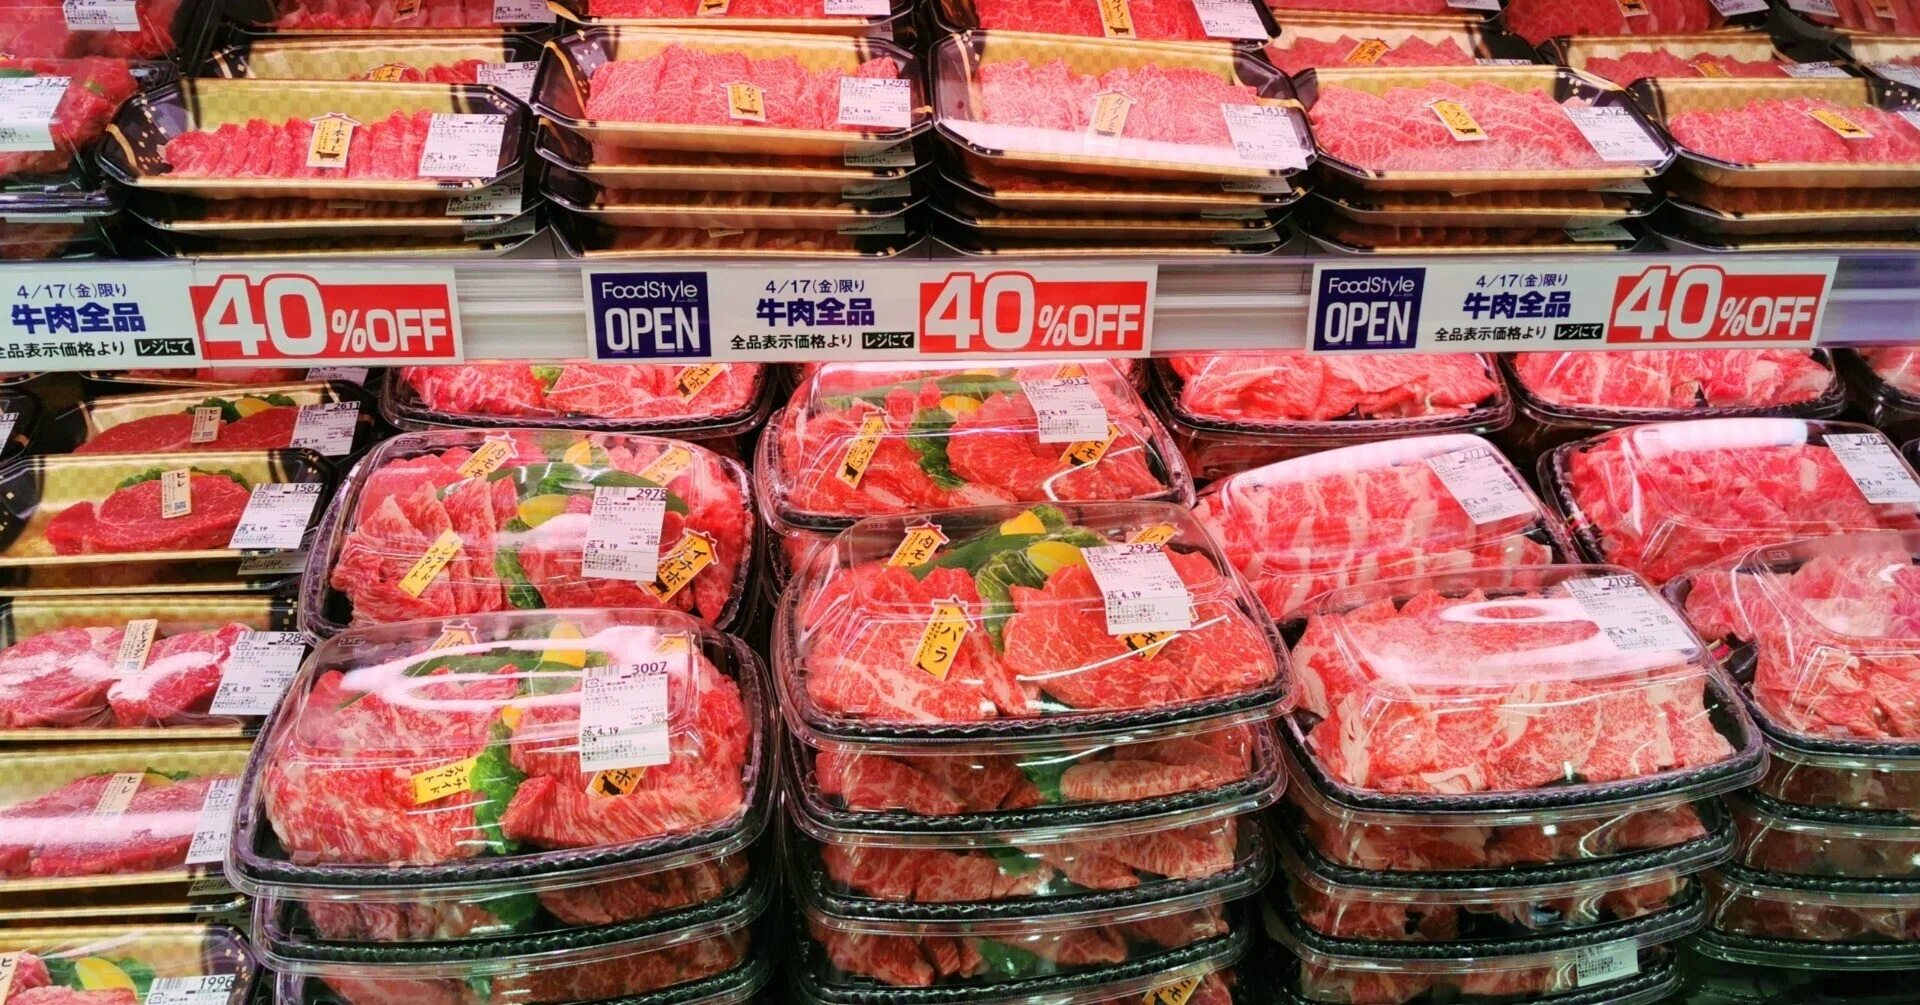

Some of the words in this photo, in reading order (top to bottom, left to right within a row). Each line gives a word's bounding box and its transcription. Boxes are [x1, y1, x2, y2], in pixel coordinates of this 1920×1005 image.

[765, 279, 866, 294] 4/17(金)限り
[1327, 276, 1416, 297] FoodStyle
[1475, 273, 1569, 289] 4/17(金)限り
[16, 283, 127, 299] 4/17(金)限り
[602, 280, 698, 302] FoodStyle
[756, 298, 875, 327] 牛肉全品
[1462, 291, 1572, 320] 牛肉全品
[11, 302, 147, 335] 牛肉全品
[1323, 301, 1411, 344] OPEN
[604, 307, 699, 350] OPEN
[1434, 326, 1547, 342] 全品表示価格より
[1557, 324, 1602, 338] レジにて
[138, 340, 190, 354] レジにて
[730, 334, 853, 350] 全品表示価格より
[864, 333, 912, 348] レジにて
[333, 402, 360, 410] 2611
[208, 409, 218, 421] ヒレ
[176, 472, 186, 488] ヒレ
[635, 488, 668, 499] 2978
[665, 550, 708, 586] イチボ
[278, 632, 304, 643] 328
[933, 626, 964, 663] バラ
[631, 661, 668, 675] 3007
[424, 765, 464, 783] スカート
[121, 776, 137, 794] ヒレ
[429, 775, 467, 795] ンサイド
[200, 976, 235, 990] 1996
